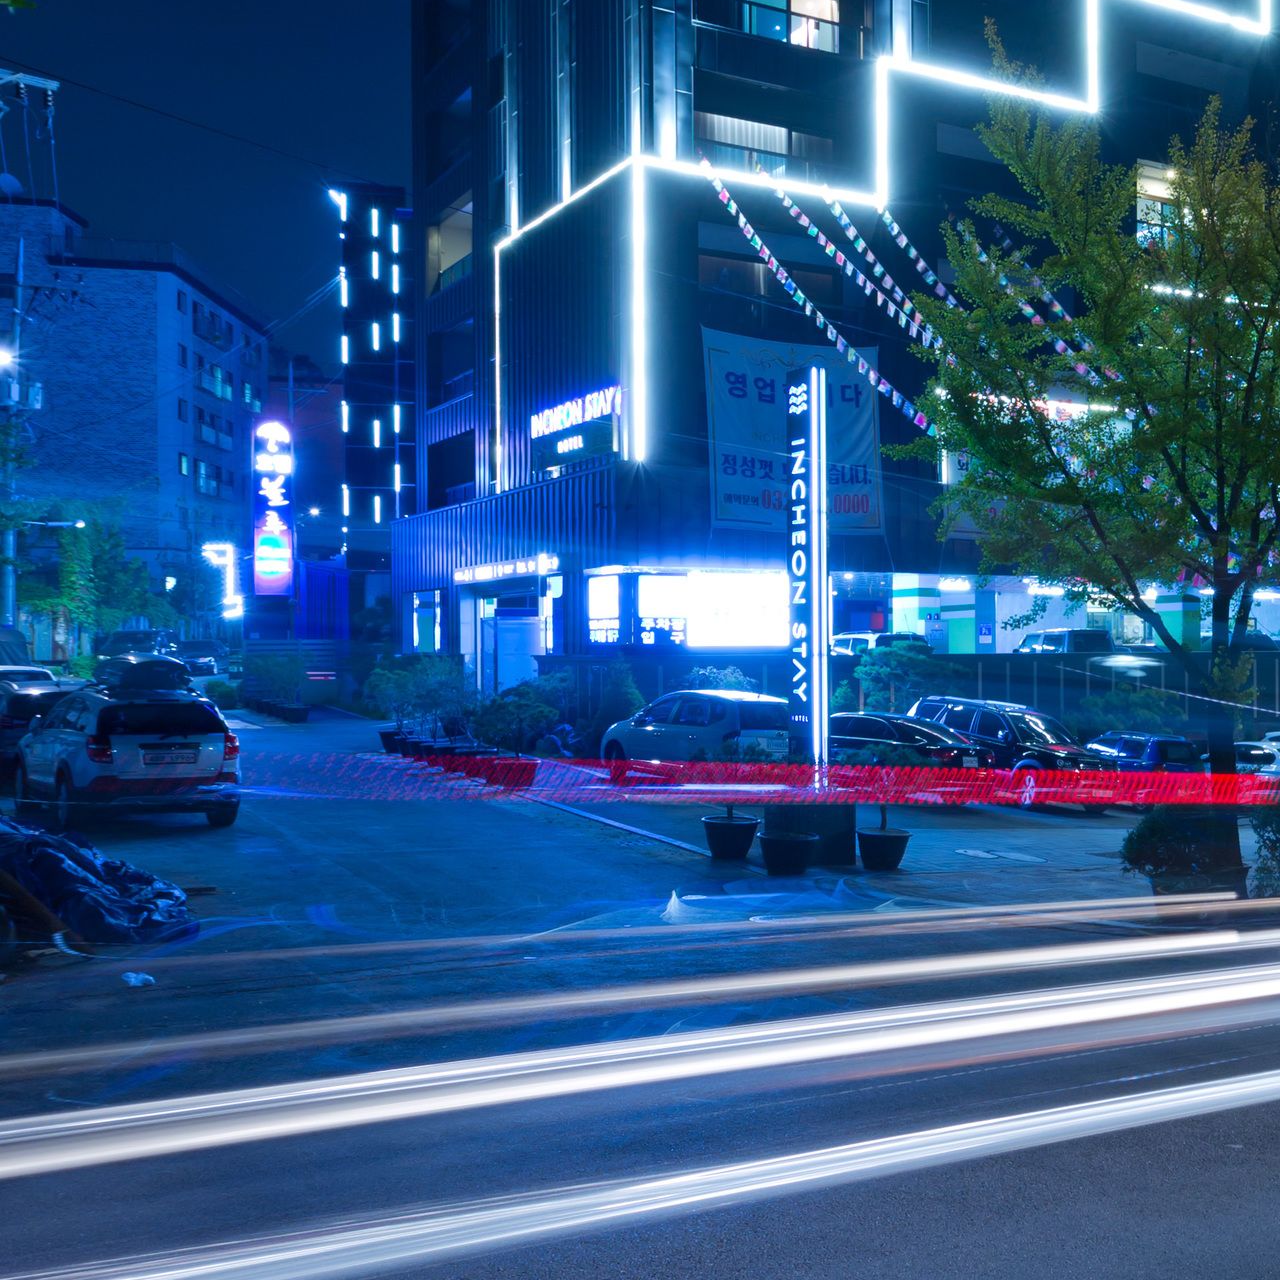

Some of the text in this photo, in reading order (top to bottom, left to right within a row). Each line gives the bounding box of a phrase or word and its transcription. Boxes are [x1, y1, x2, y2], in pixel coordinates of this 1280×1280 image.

[530, 386, 614, 439] INCHEON STAY
[724, 371, 863, 409] 영업다
[791, 438, 807, 702] INCHEON STAY
